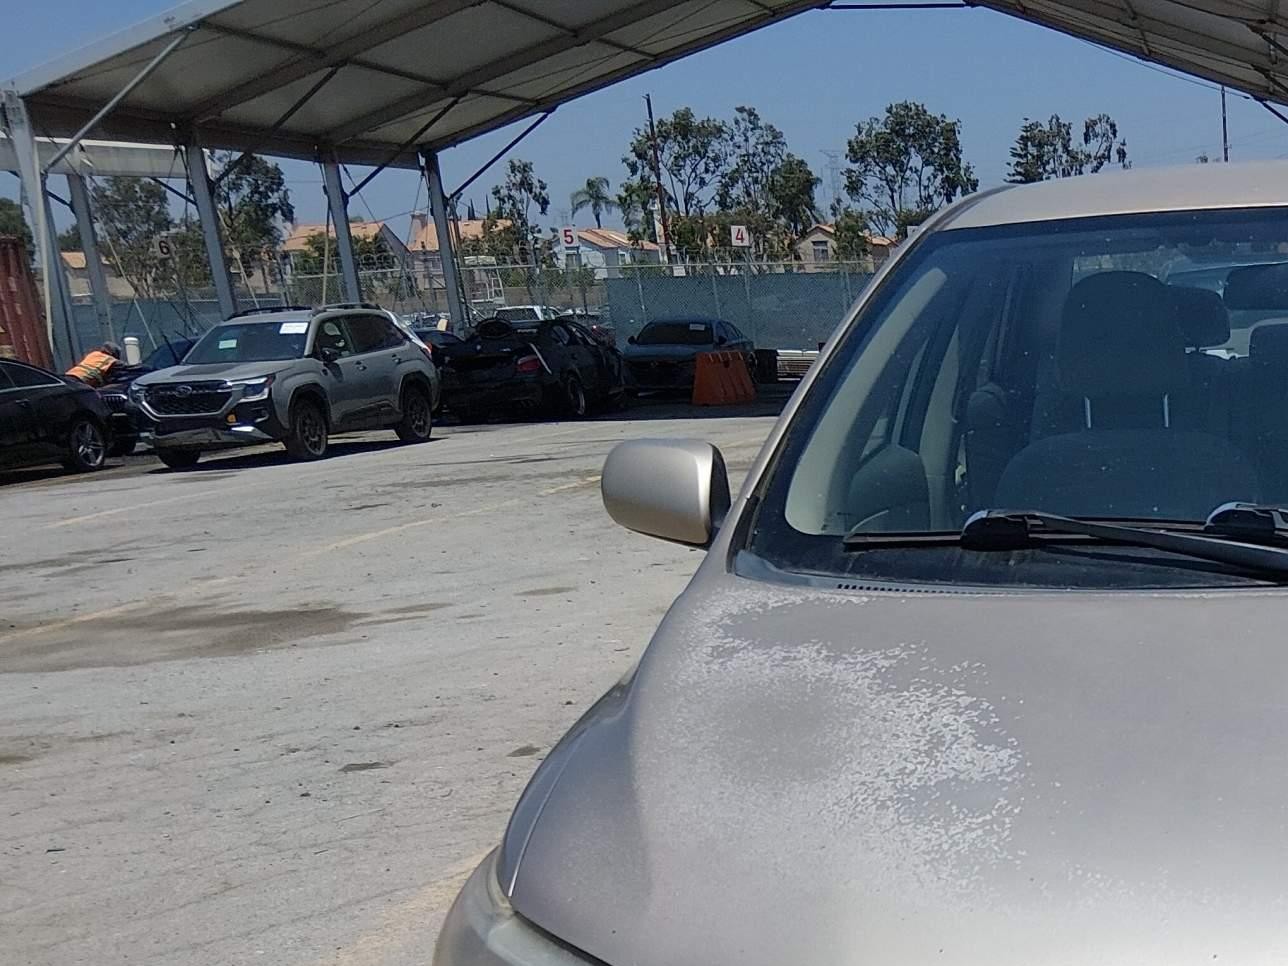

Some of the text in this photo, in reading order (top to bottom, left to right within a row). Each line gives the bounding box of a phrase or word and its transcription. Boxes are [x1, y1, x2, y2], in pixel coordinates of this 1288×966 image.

[564, 229, 573, 245] 5
[736, 228, 745, 243] 4
[159, 240, 170, 255] 6
